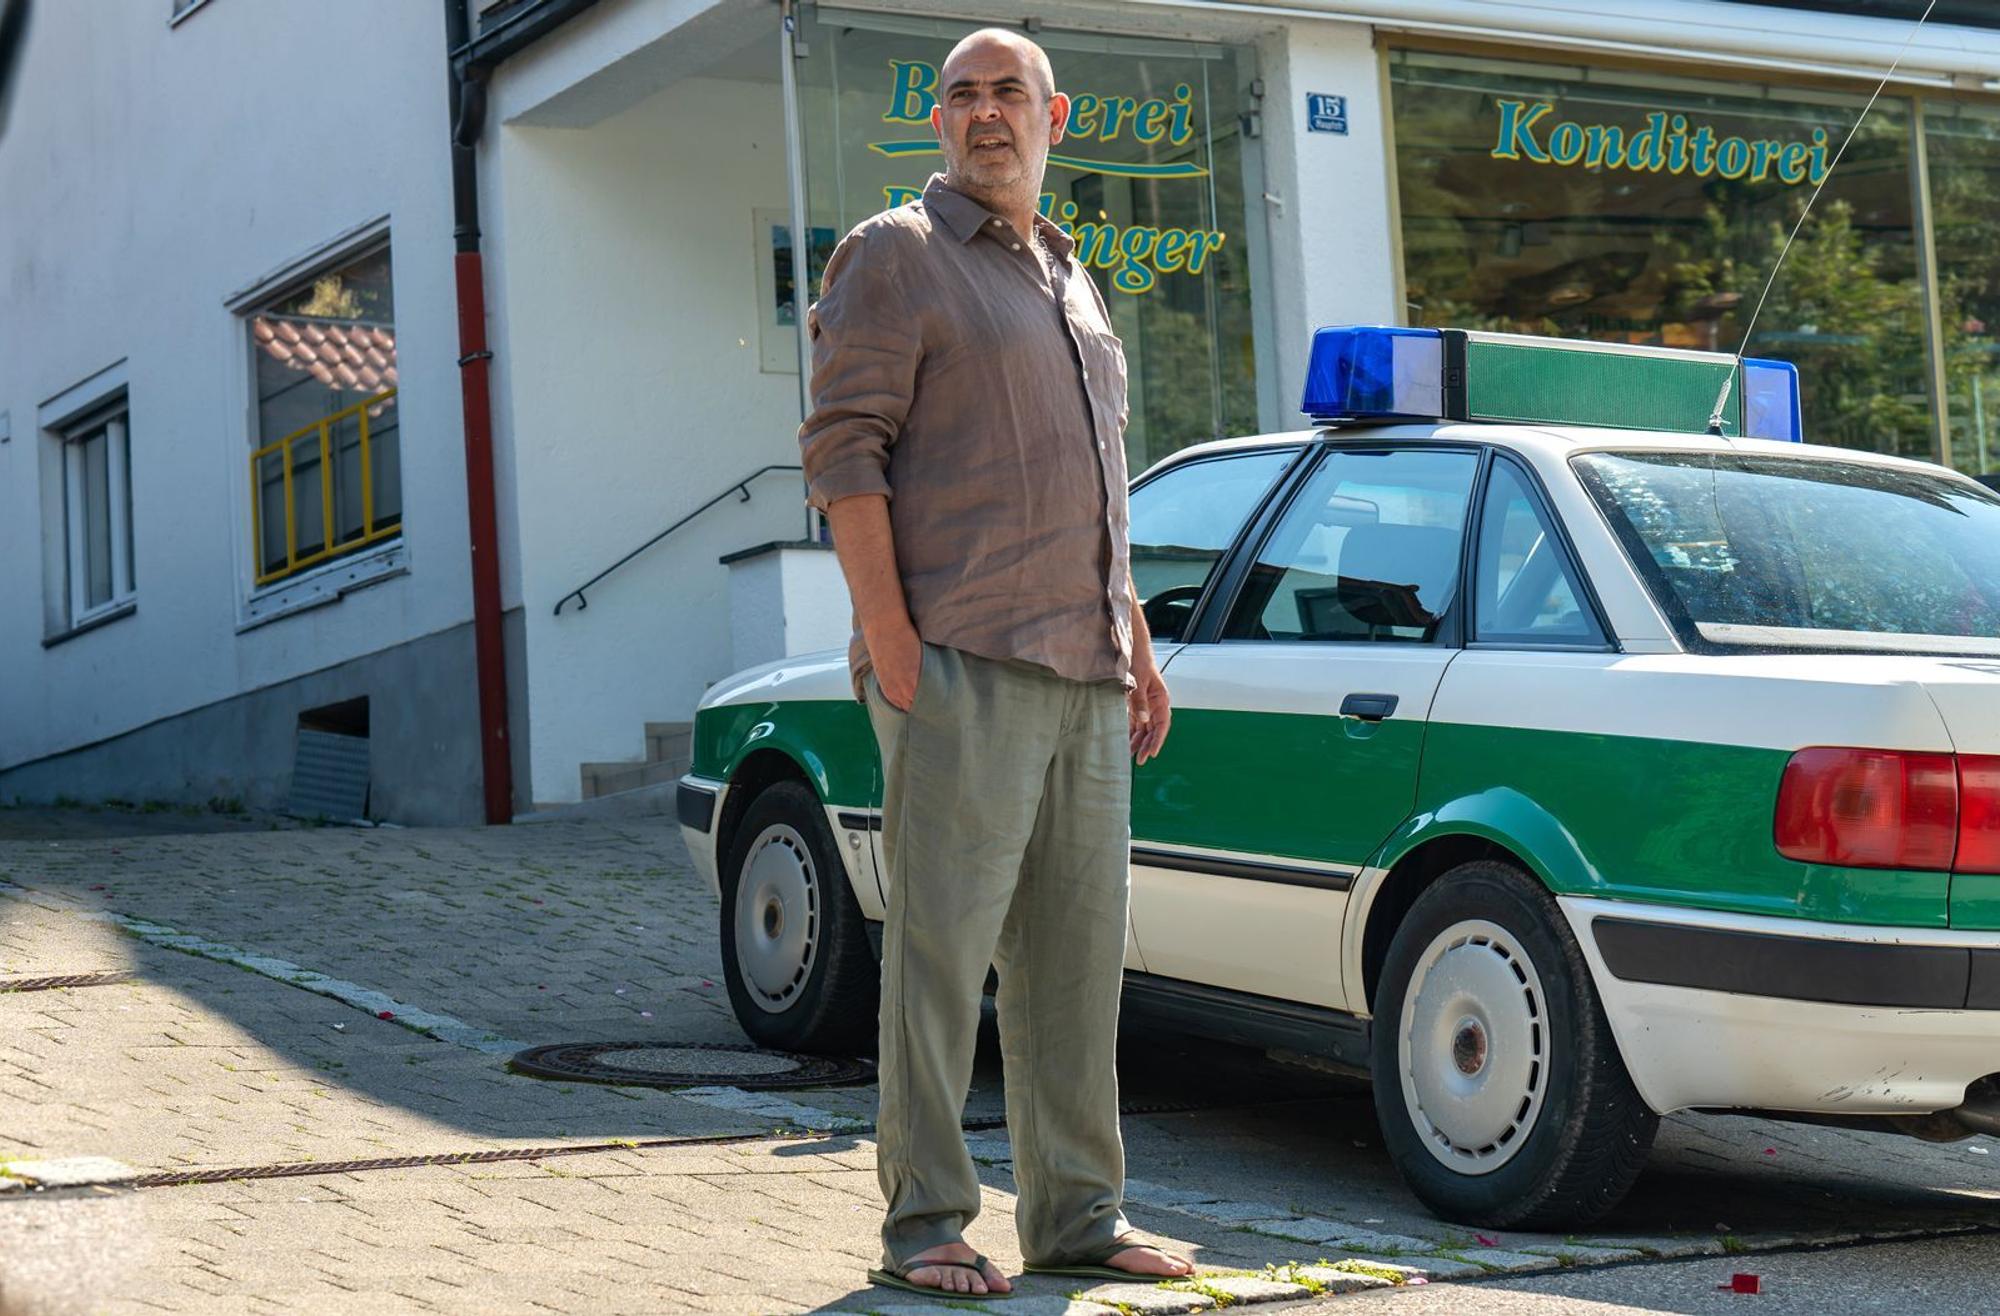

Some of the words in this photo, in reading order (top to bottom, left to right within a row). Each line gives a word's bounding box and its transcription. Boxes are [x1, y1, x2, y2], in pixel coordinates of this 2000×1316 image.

[880, 59, 1193, 146] Berei
[1317, 96, 1341, 117] 15
[1490, 99, 1831, 186] Konditorei
